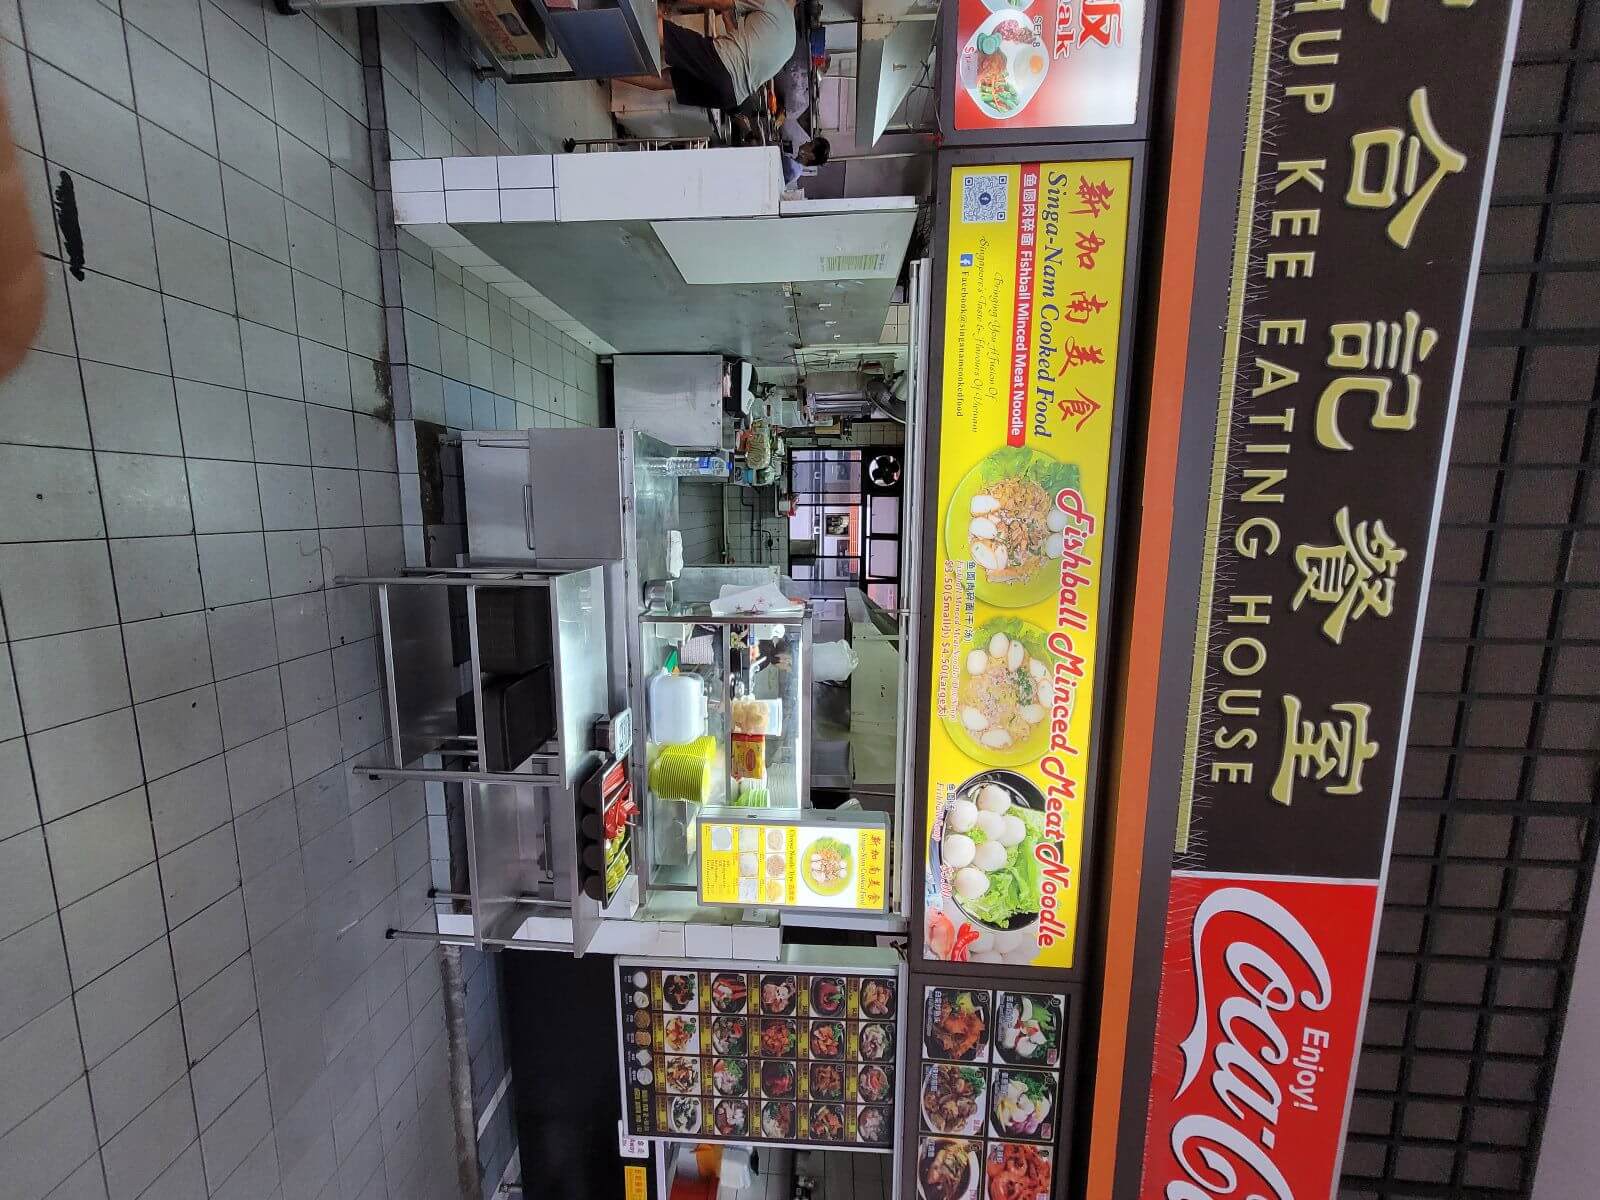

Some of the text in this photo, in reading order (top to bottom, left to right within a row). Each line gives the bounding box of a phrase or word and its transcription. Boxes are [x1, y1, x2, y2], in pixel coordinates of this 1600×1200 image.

[1266, 159, 1326, 278] KEE
[988, 272, 1004, 318] Bringing
[1017, 250, 1033, 300] Fishball
[976, 296, 987, 321] Taste
[1014, 303, 1030, 351] Minced
[1033, 171, 1068, 438] Singa-Nam Cooked Food
[1057, 175, 1114, 432] 新加南美食
[988, 320, 1000, 342] You
[973, 338, 985, 376] Flavours
[989, 357, 1000, 385] Fusion
[1013, 354, 1026, 388] Meat
[971, 379, 983, 390] Of
[985, 387, 998, 400] Of
[1270, 0, 1476, 804] 合記餐室
[971, 393, 983, 433] Vietnam
[1011, 390, 1025, 436] Noodle
[1234, 320, 1306, 559] EATING
[1210, 596, 1272, 784] HOUSE
[1034, 488, 1095, 947] Fishball Minced Meat Noodle
[1288, 1027, 1329, 1111] Enjoy!
